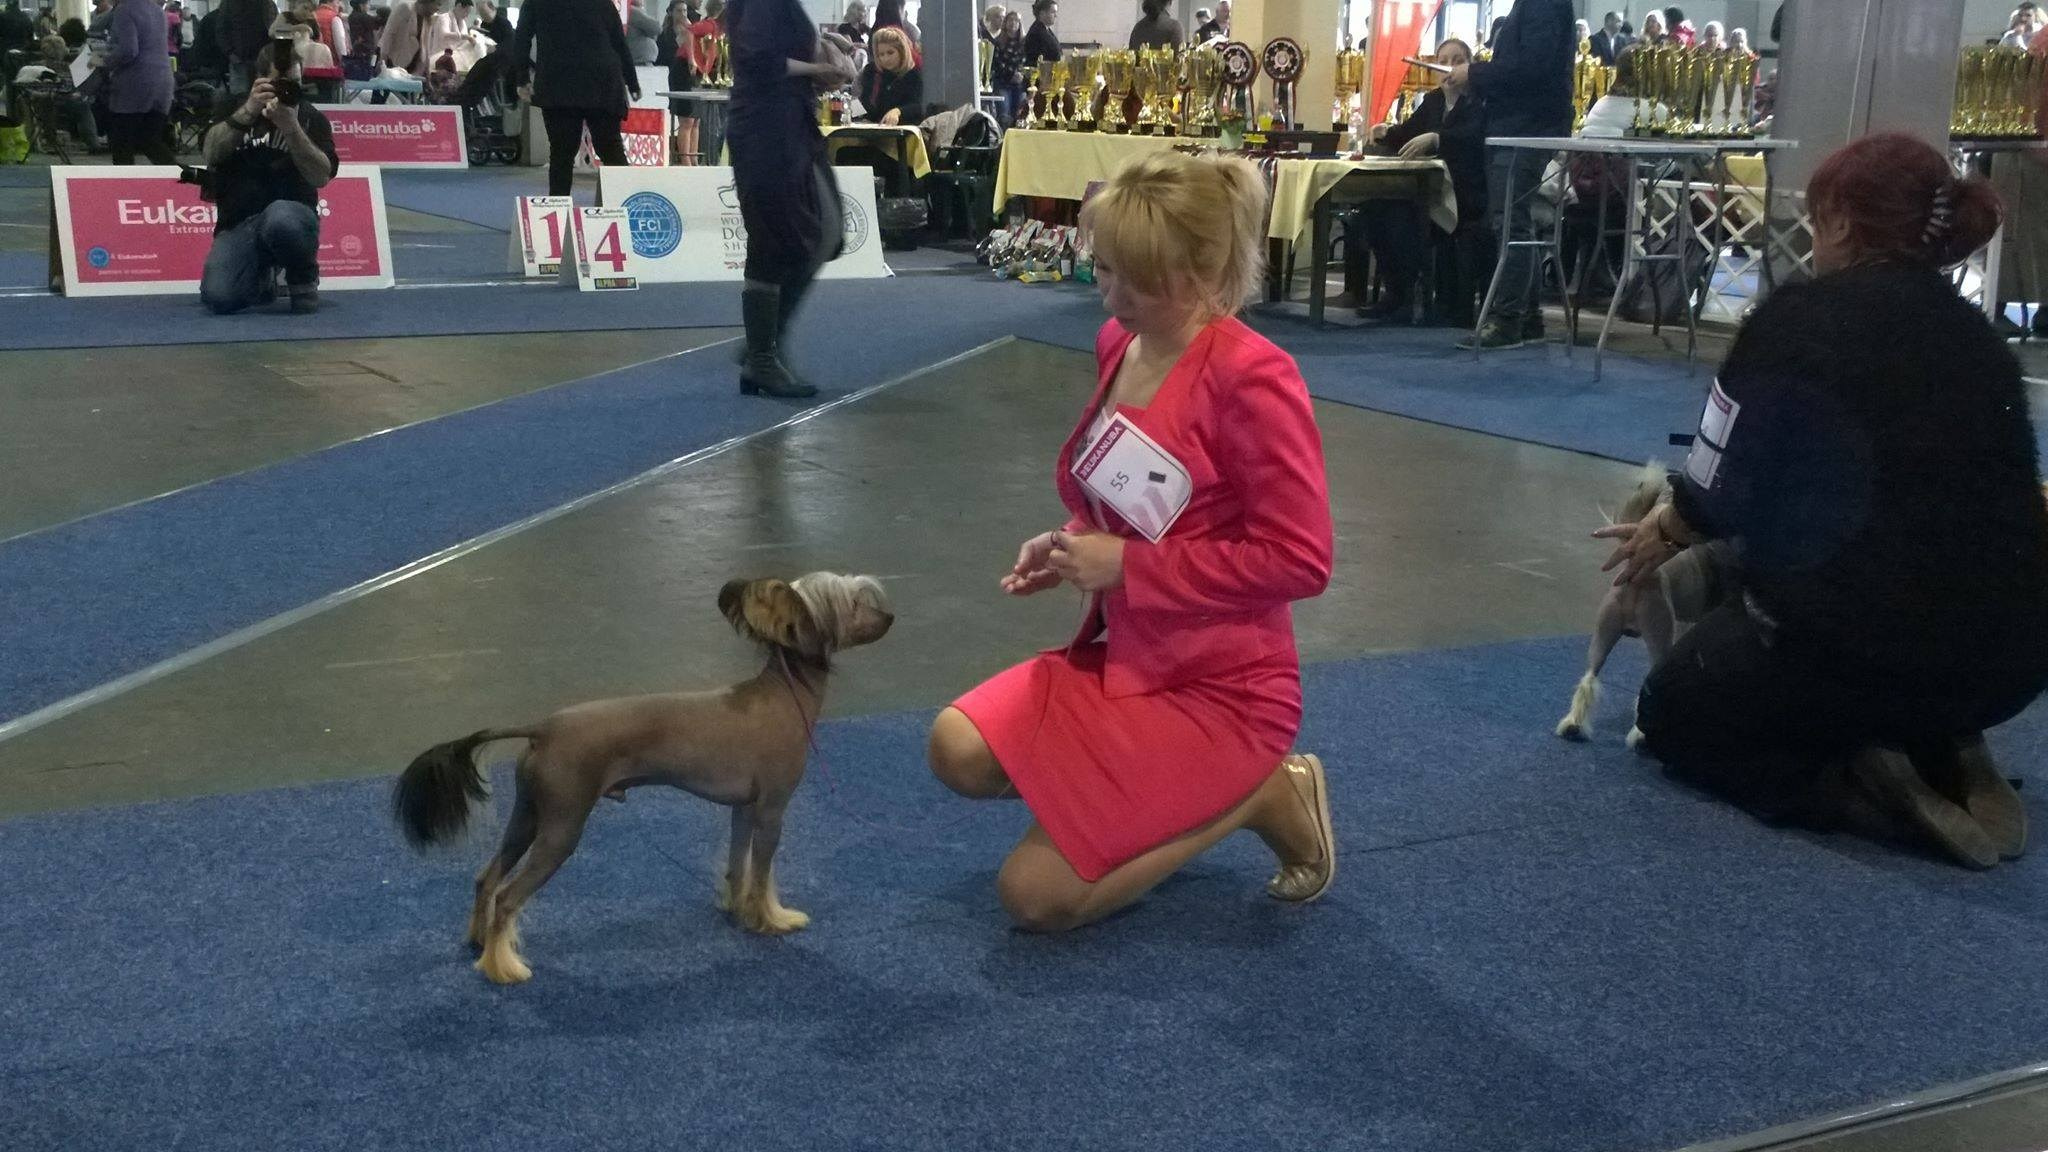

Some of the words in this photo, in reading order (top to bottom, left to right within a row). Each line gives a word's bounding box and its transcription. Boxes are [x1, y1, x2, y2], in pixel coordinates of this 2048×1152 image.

[330, 119, 422, 134] Eukanuba
[540, 211, 562, 258] 1
[639, 219, 661, 231] FCI
[595, 222, 627, 272] 4
[1110, 471, 1130, 492] 55
